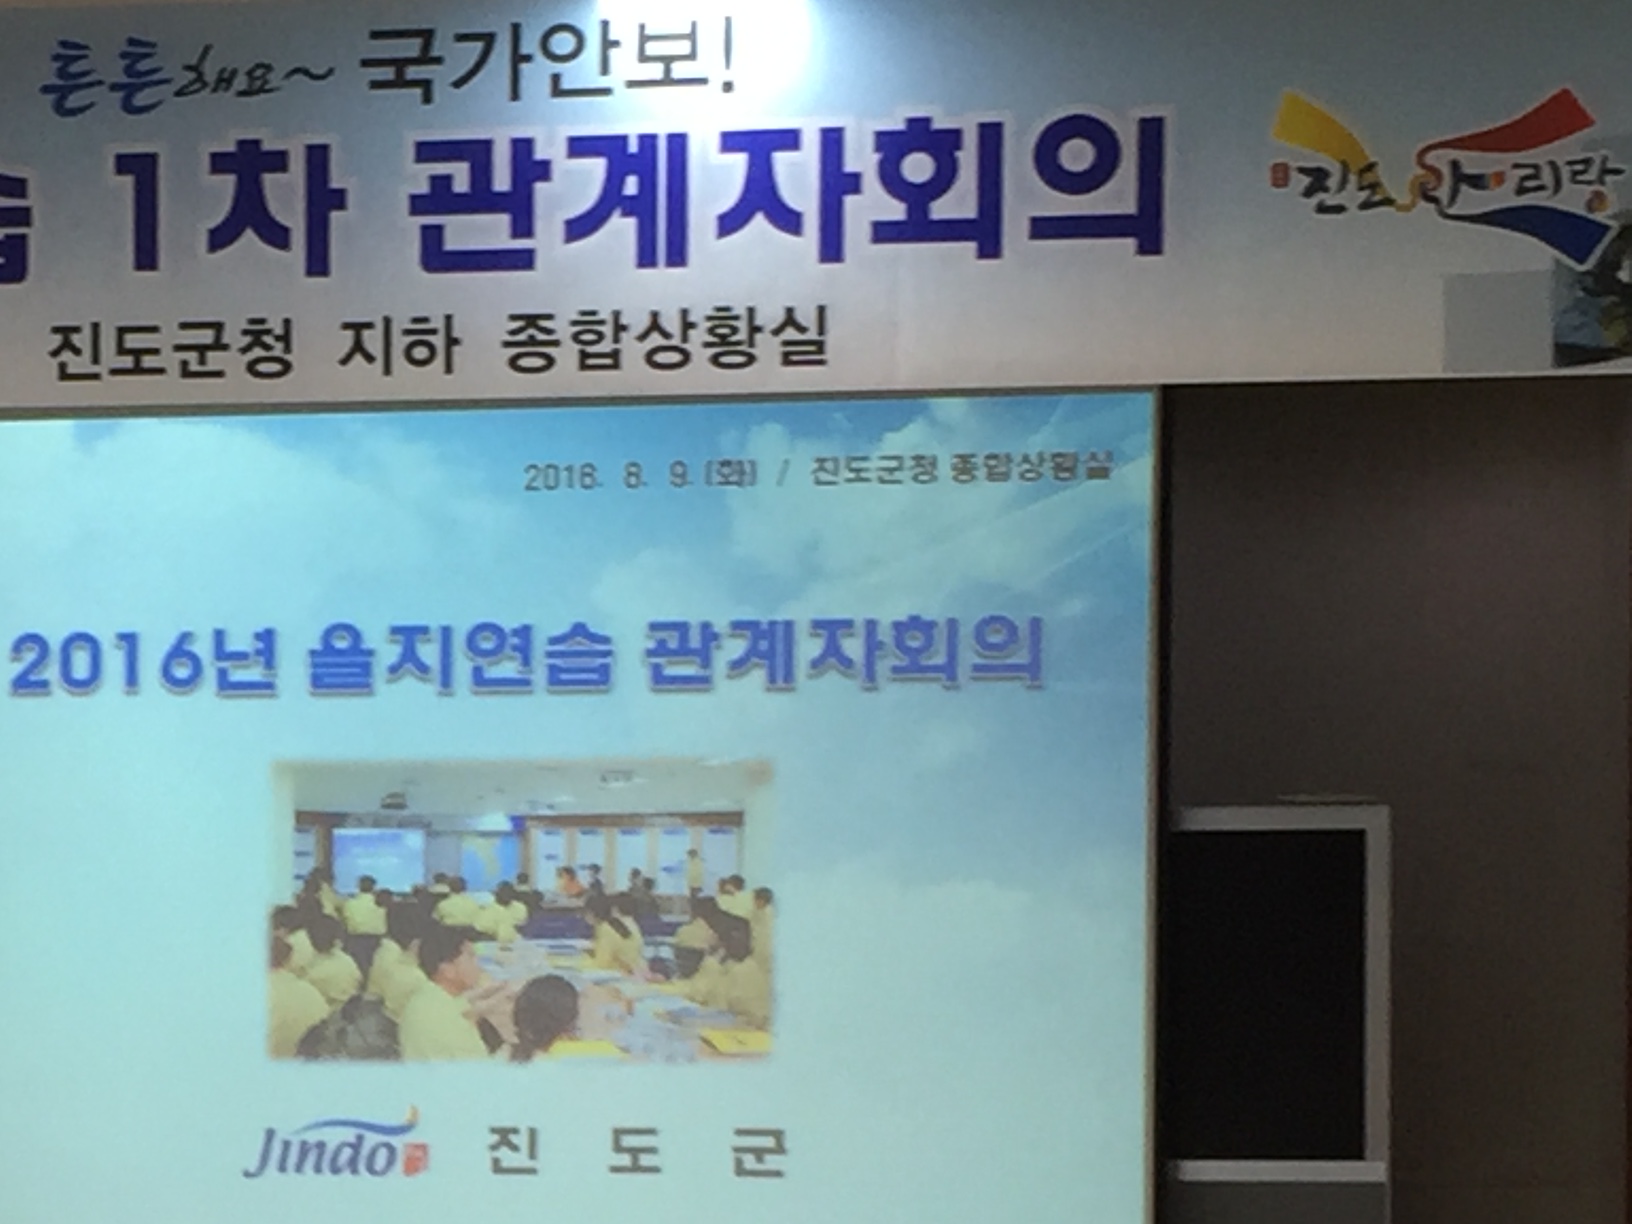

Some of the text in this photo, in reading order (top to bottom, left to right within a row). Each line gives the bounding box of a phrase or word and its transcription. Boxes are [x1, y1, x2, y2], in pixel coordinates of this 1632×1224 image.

[40, 37, 336, 117] 튼튼해요~
[360, 15, 736, 108] 국가안보!
[114, 138, 348, 279] 1차
[408, 112, 1166, 276] 관계자회의
[48, 317, 295, 383] 진도군청
[338, 313, 462, 378] 지하
[500, 304, 830, 375] 종합상황실
[811, 454, 940, 485] 진도군청
[10, 614, 1047, 698] 2016년 을지연습 관계자회의
[242, 1127, 398, 1179] Jindo
